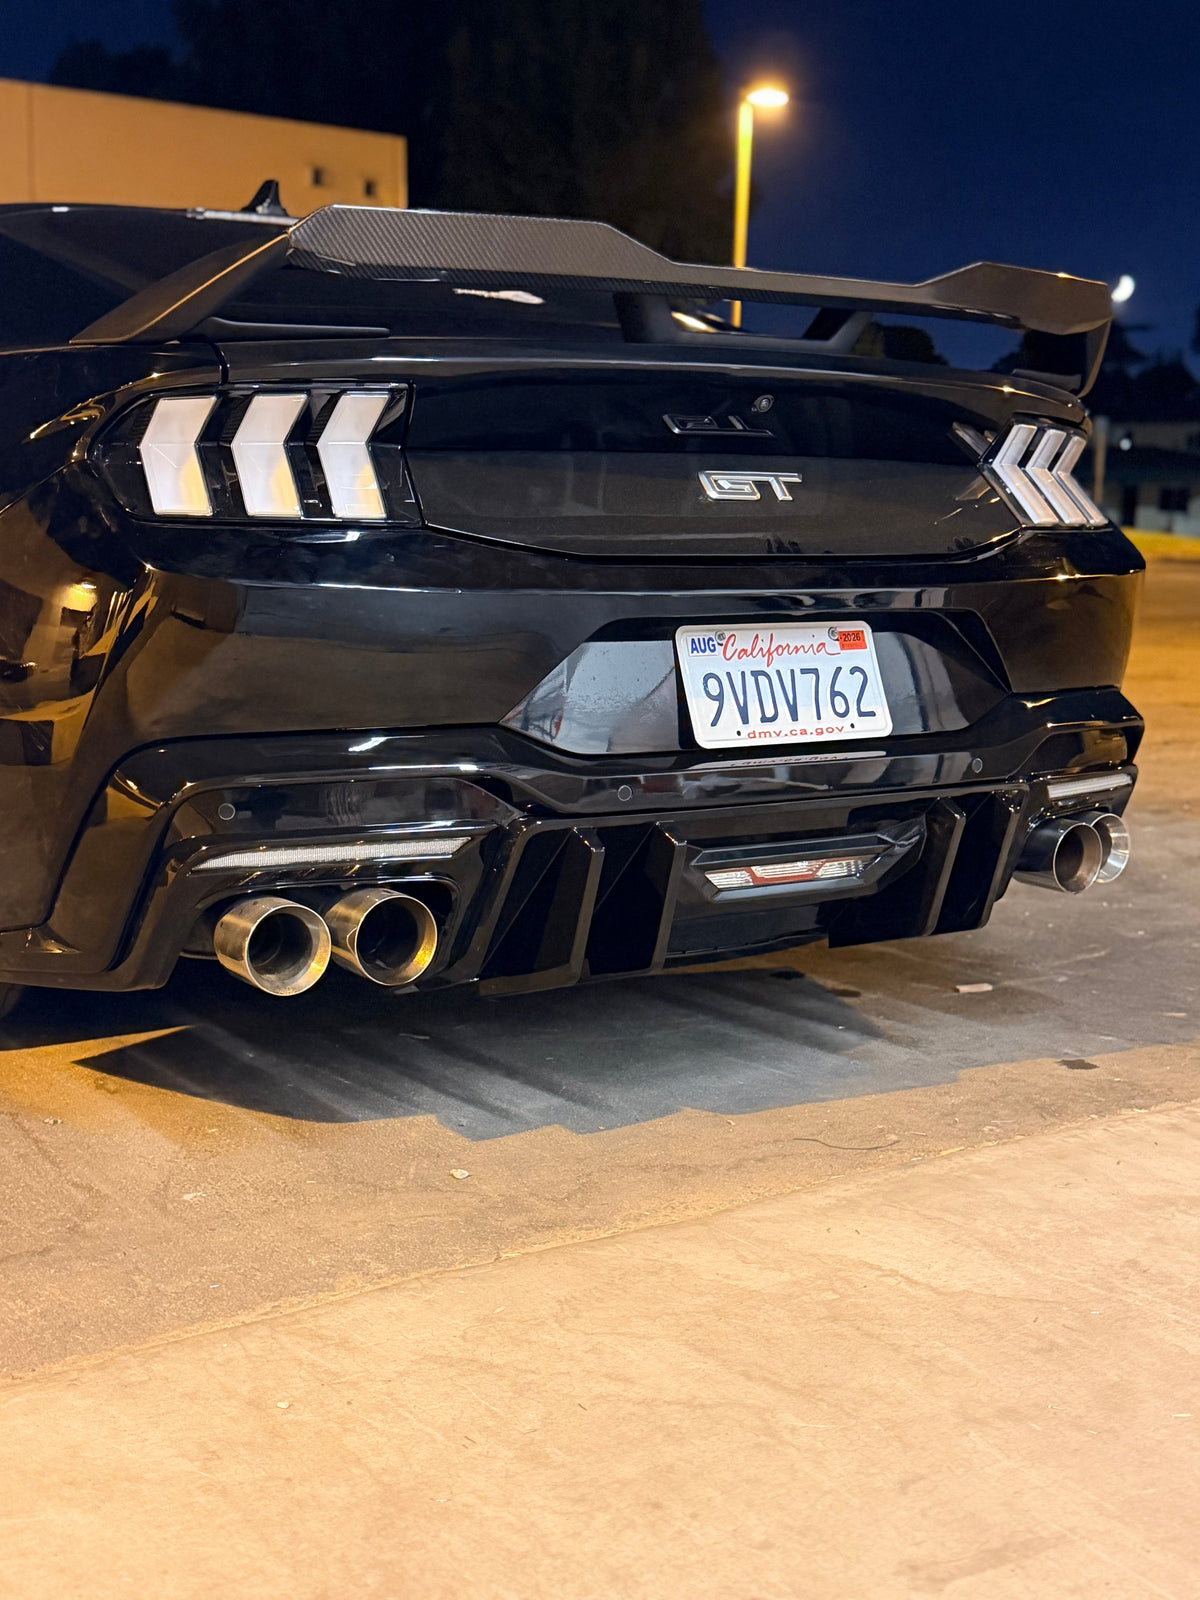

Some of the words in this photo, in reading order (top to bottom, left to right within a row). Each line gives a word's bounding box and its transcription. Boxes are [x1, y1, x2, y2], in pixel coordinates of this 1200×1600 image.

[697, 470, 802, 501] GT
[690, 636, 717, 655] AUG
[842, 632, 862, 643] 2026
[722, 633, 841, 668] California
[703, 666, 876, 727] 9VDV762
[747, 724, 845, 739] dmv.ca.gov
